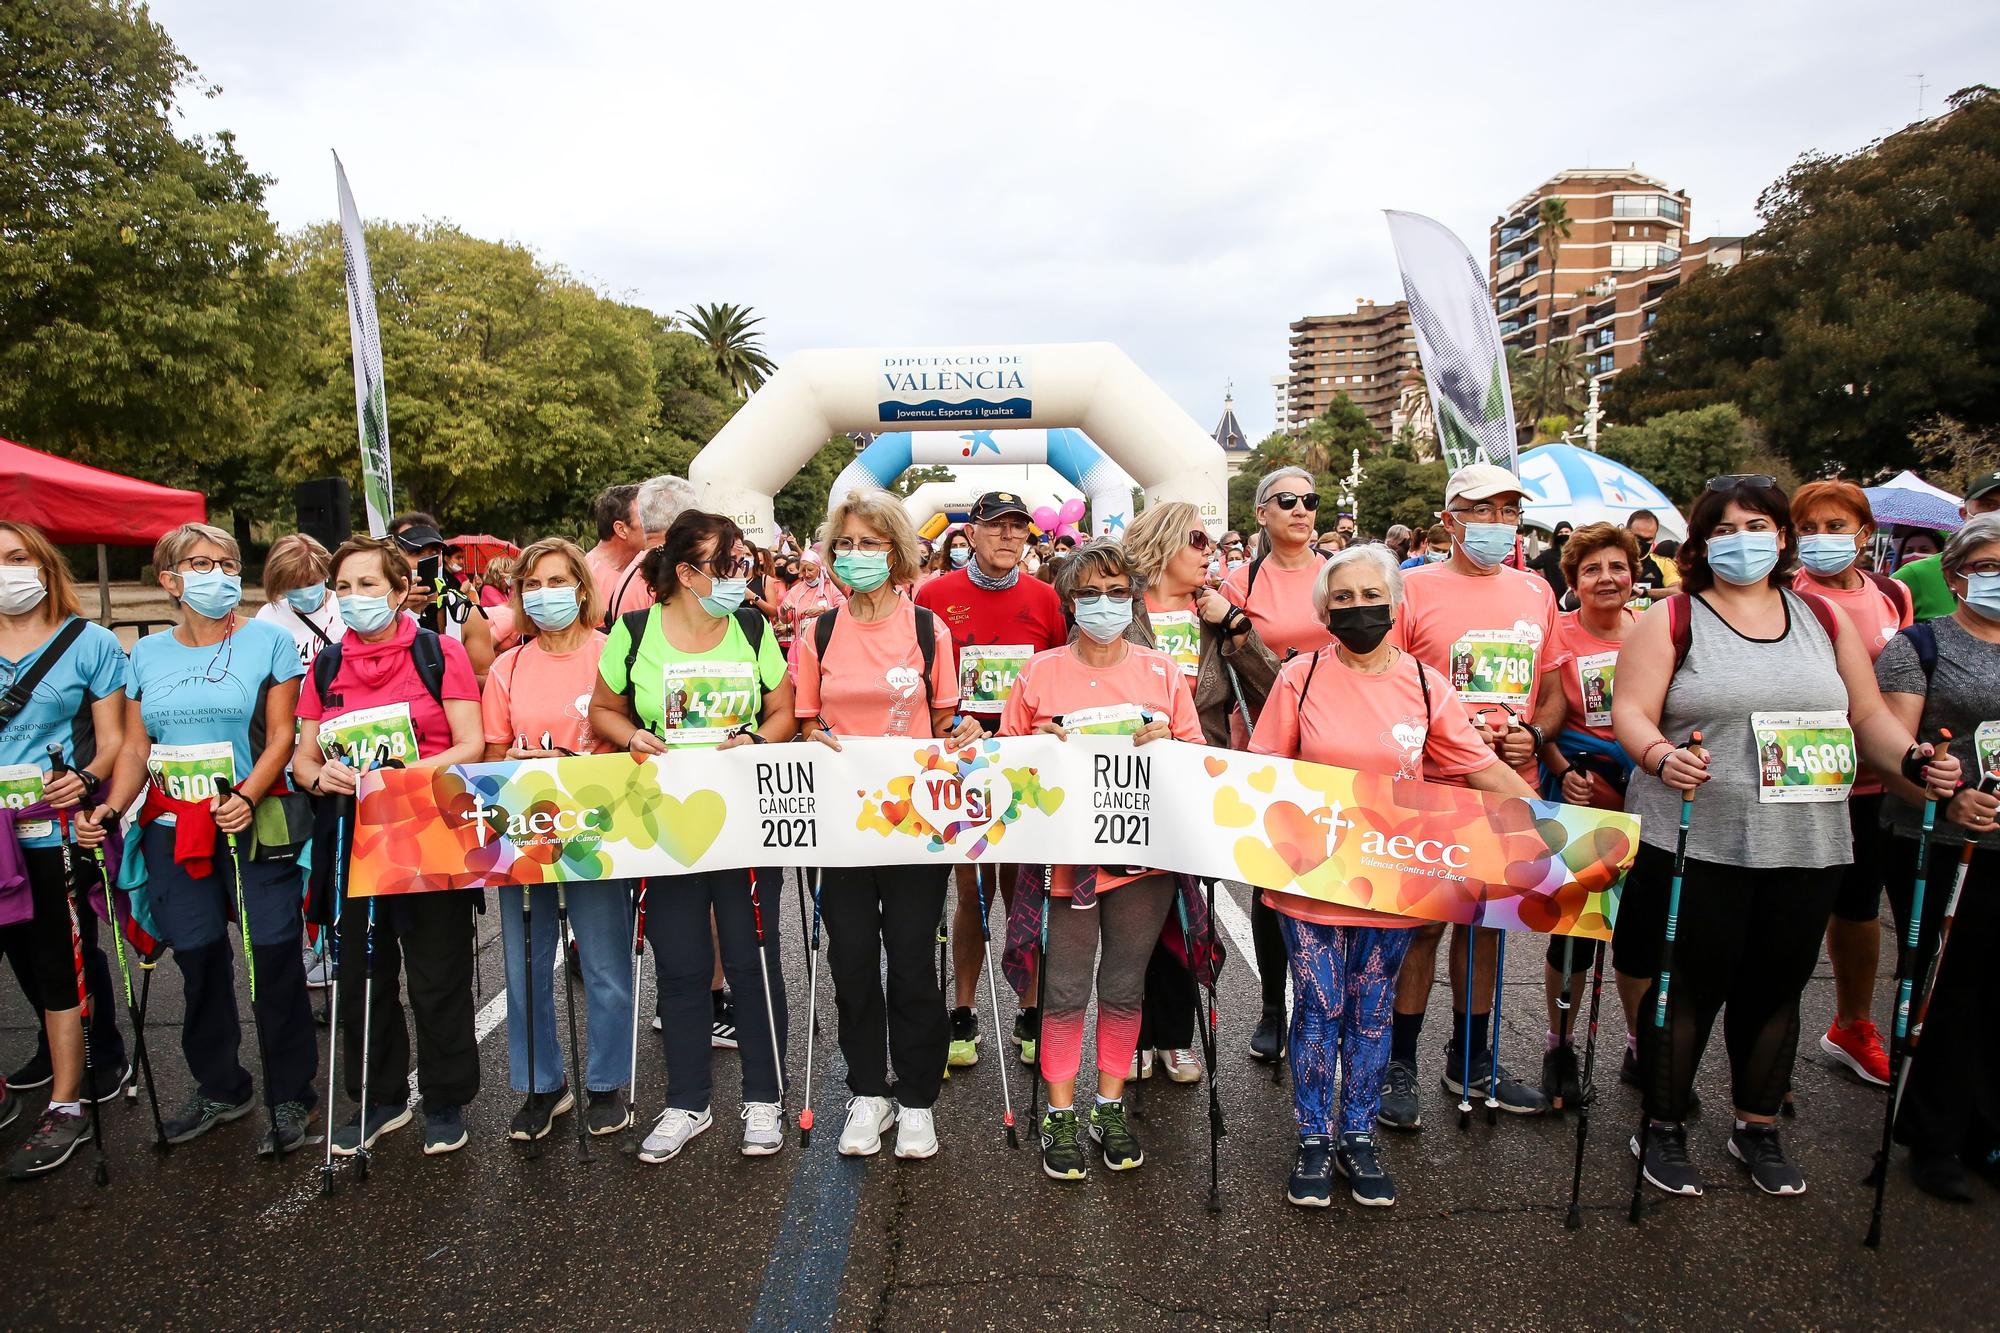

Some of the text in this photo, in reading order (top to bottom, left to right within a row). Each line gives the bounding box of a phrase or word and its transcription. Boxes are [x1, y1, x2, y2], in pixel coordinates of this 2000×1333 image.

[885, 355, 1023, 367] DIPUTACIÓ DE
[884, 368, 1025, 391] VALÈNCIA
[938, 408, 973, 418] Esports
[981, 407, 1014, 417] Igualtat
[1200, 502, 1217, 516] cia
[742, 527, 764, 536] sports
[1202, 518, 1223, 526] sports
[1156, 634, 1201, 656] 524
[1475, 656, 1529, 687] 4798
[144, 707, 243, 720] CIETAT EXCURSIONISTA
[689, 690, 751, 718] 4277
[3, 721, 58, 733] CURSIONISTA
[159, 718, 171, 727] DE
[1766, 765, 1782, 773] MAR
[1786, 743, 1853, 774] 4688
[756, 761, 814, 795] RUN
[1094, 753, 1151, 790] RUN
[1766, 773, 1782, 781] CHA
[759, 794, 816, 814] CÁNCER
[926, 778, 962, 811] YO
[1093, 787, 1151, 811] CÁNCER
[506, 808, 600, 836] aecc
[1094, 814, 1149, 846] 2021
[509, 837, 538, 847] Valencia
[540, 836, 565, 845] Contra
[567, 835, 574, 843] el
[761, 819, 817, 848] 2021
[1360, 830, 1471, 869] aecc
[1360, 855, 1467, 882] Valencia Contra el Cáncer
